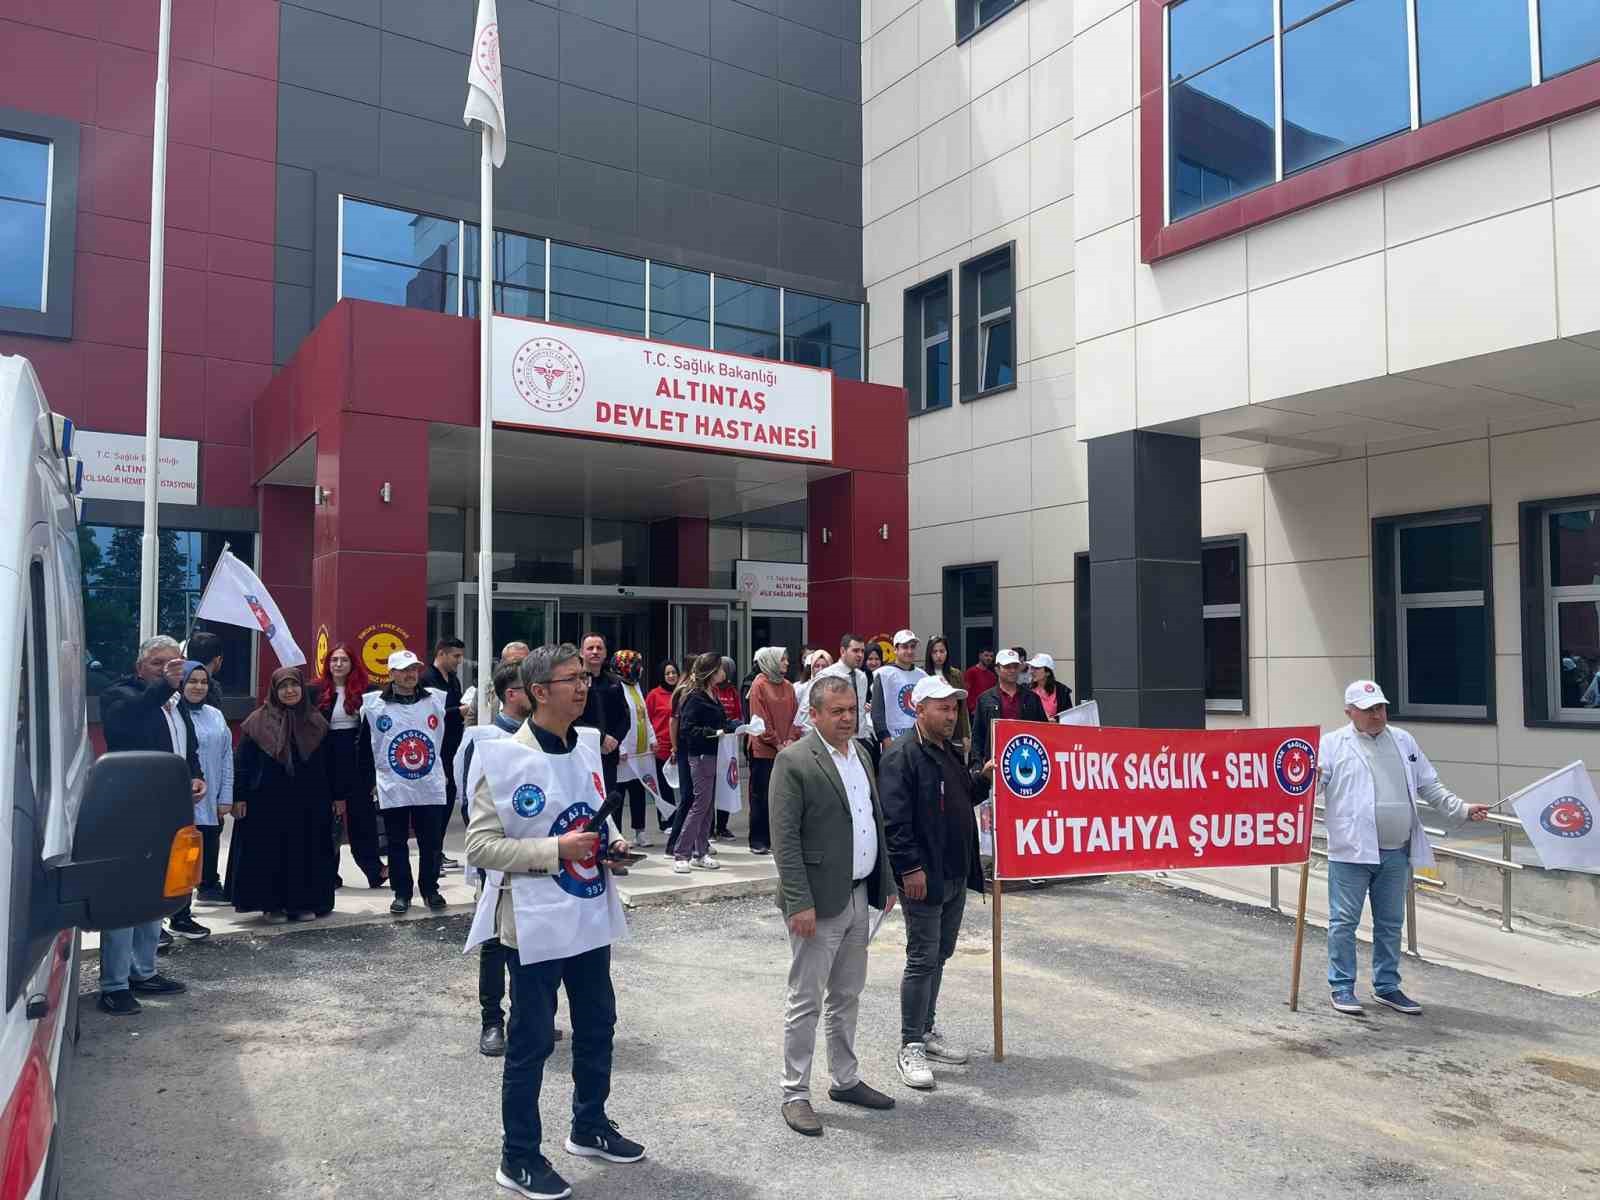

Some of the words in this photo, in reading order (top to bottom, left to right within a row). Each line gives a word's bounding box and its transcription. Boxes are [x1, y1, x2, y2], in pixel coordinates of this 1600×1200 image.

[643, 350, 671, 368] T.C.
[673, 355, 716, 376] Sağlık
[719, 363, 778, 387] Bakanlığı
[655, 376, 767, 414] ALTINTAŞ
[595, 401, 689, 433] DEVLET
[695, 414, 817, 449] HASTANESİ
[1054, 744, 1120, 790] TÜRK
[1123, 746, 1208, 790] SAĞLIK
[1211, 772, 1219, 780] -
[1225, 751, 1269, 790] SEN
[1015, 810, 1179, 857] KÜTAHYA
[1188, 804, 1305, 857] ŞUBESİ
